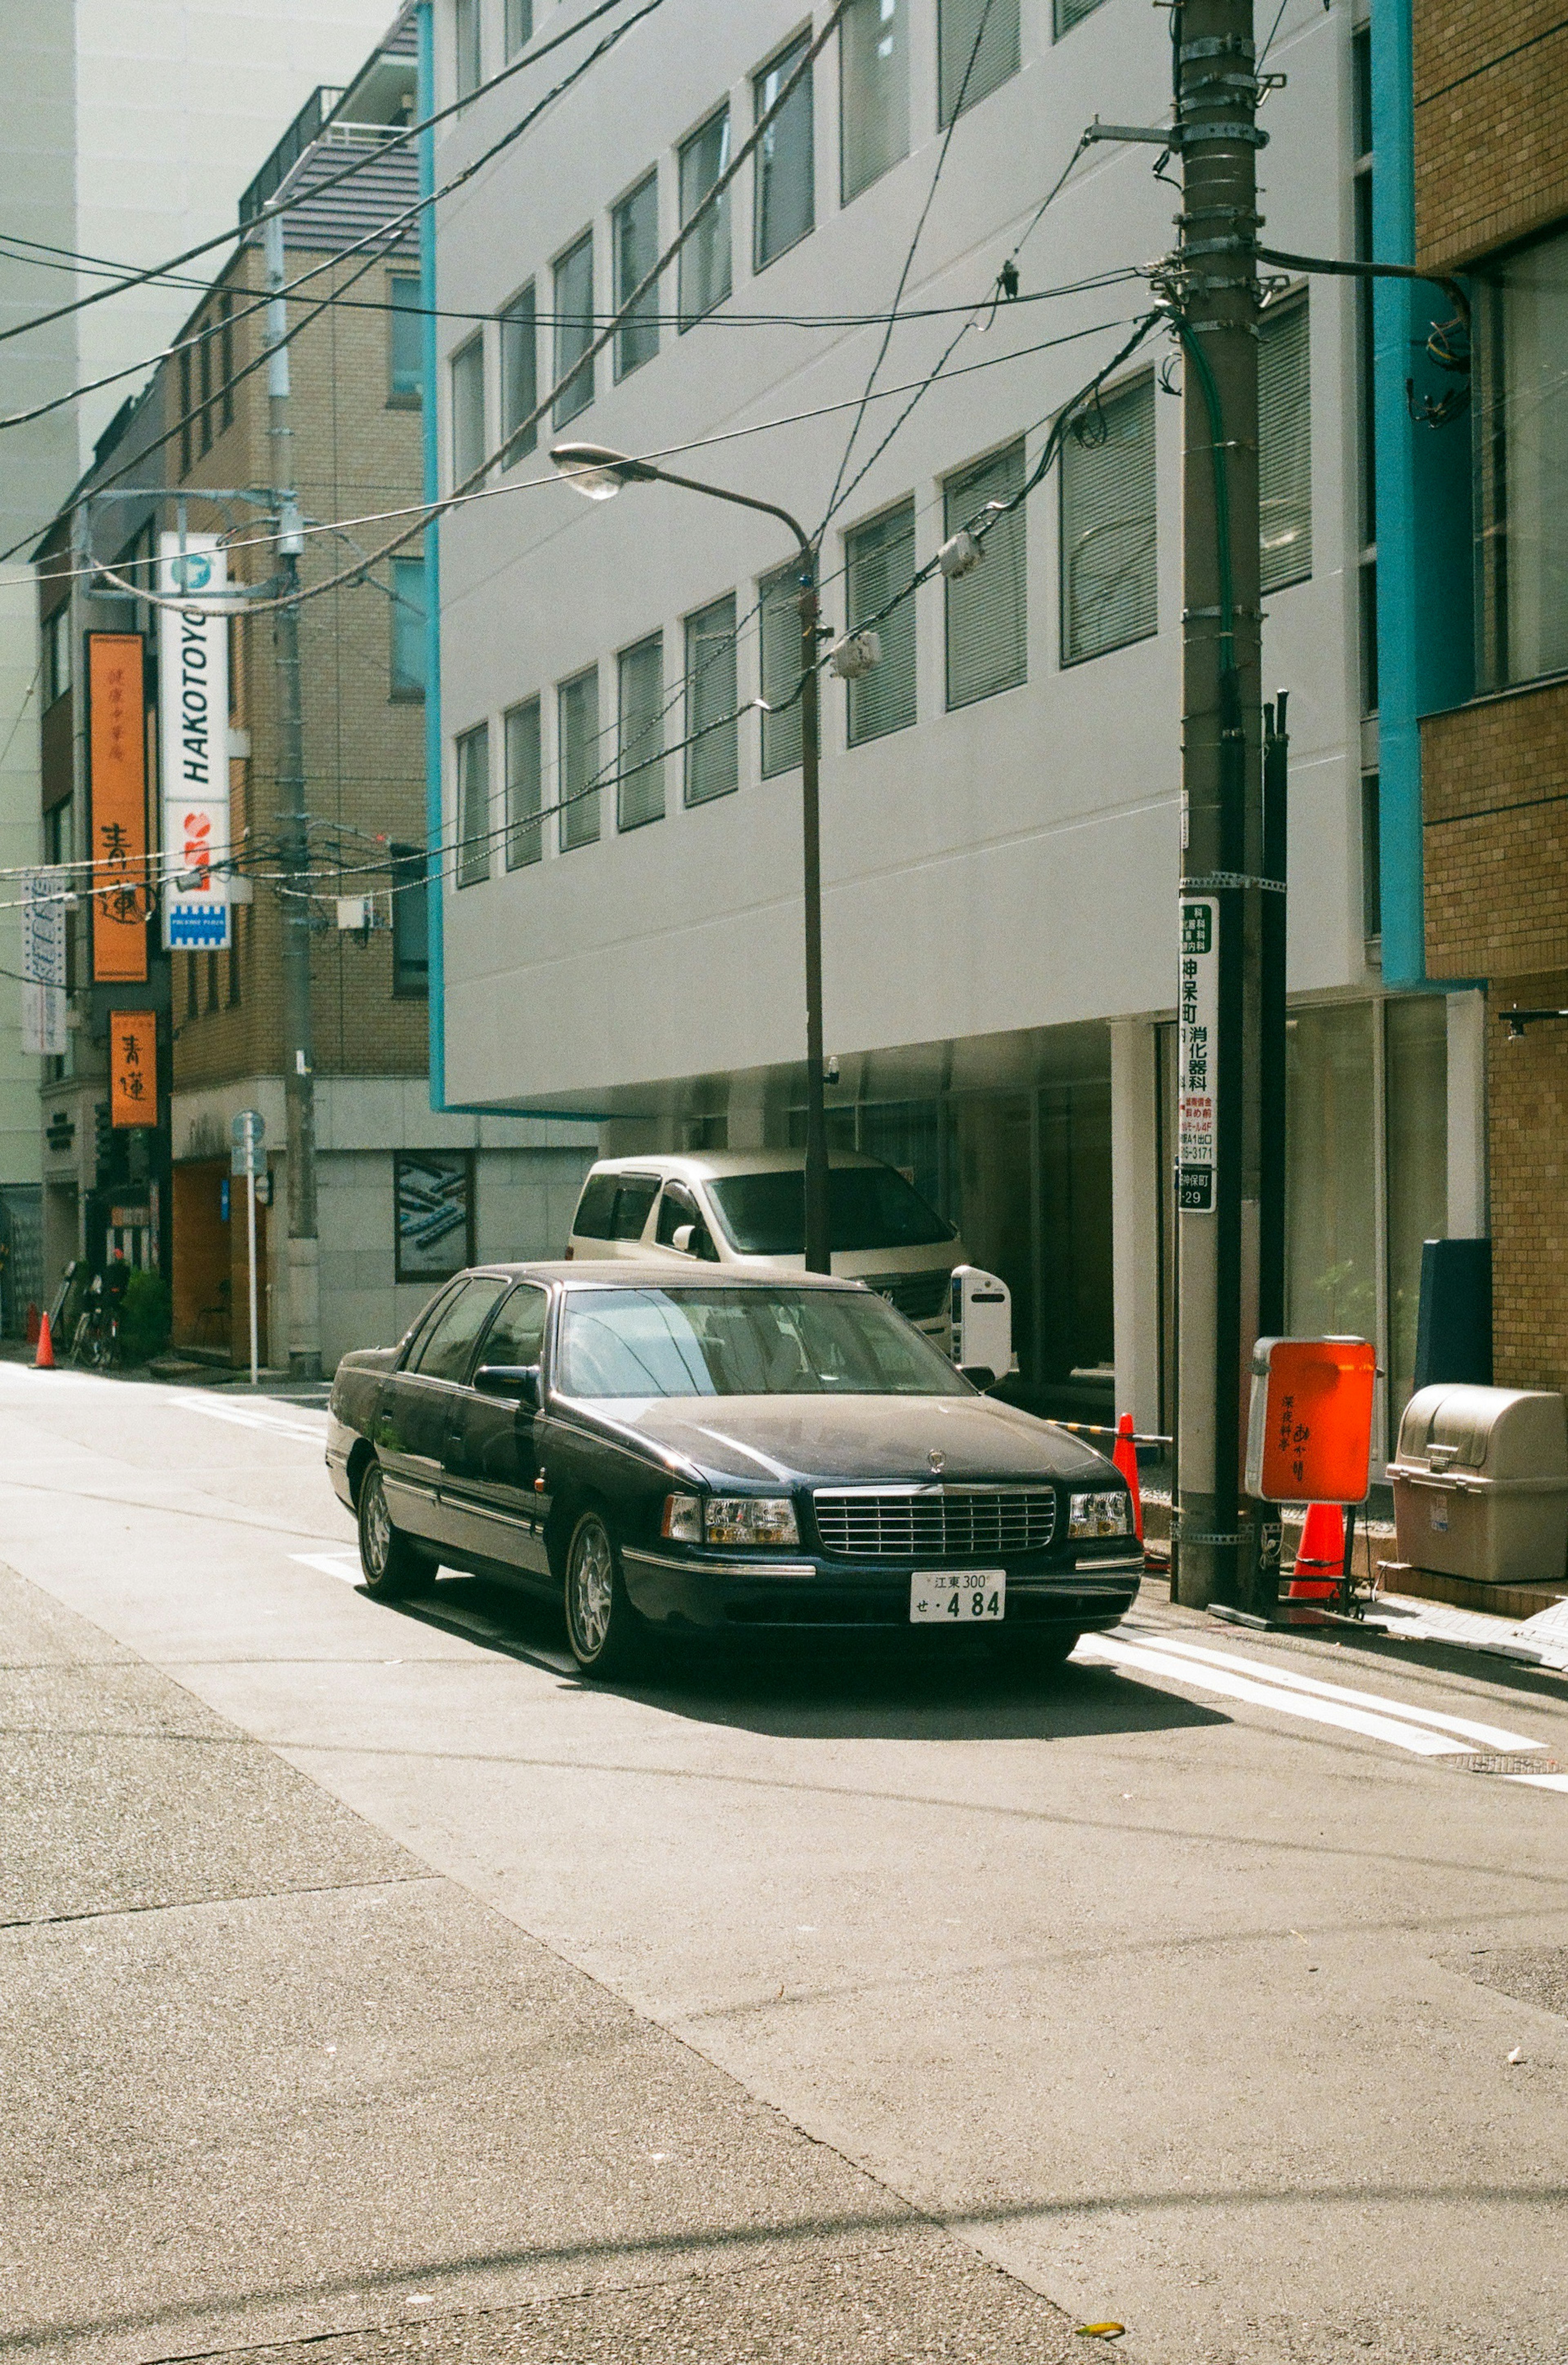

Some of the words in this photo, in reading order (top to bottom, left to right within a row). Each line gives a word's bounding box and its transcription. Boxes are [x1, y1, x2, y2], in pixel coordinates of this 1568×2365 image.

[181, 604, 209, 784] HAKOTOYO
[98, 822, 137, 925] 青蓮
[120, 1034, 146, 1101] 青蓮
[1189, 1026, 1207, 1092] 消化器科
